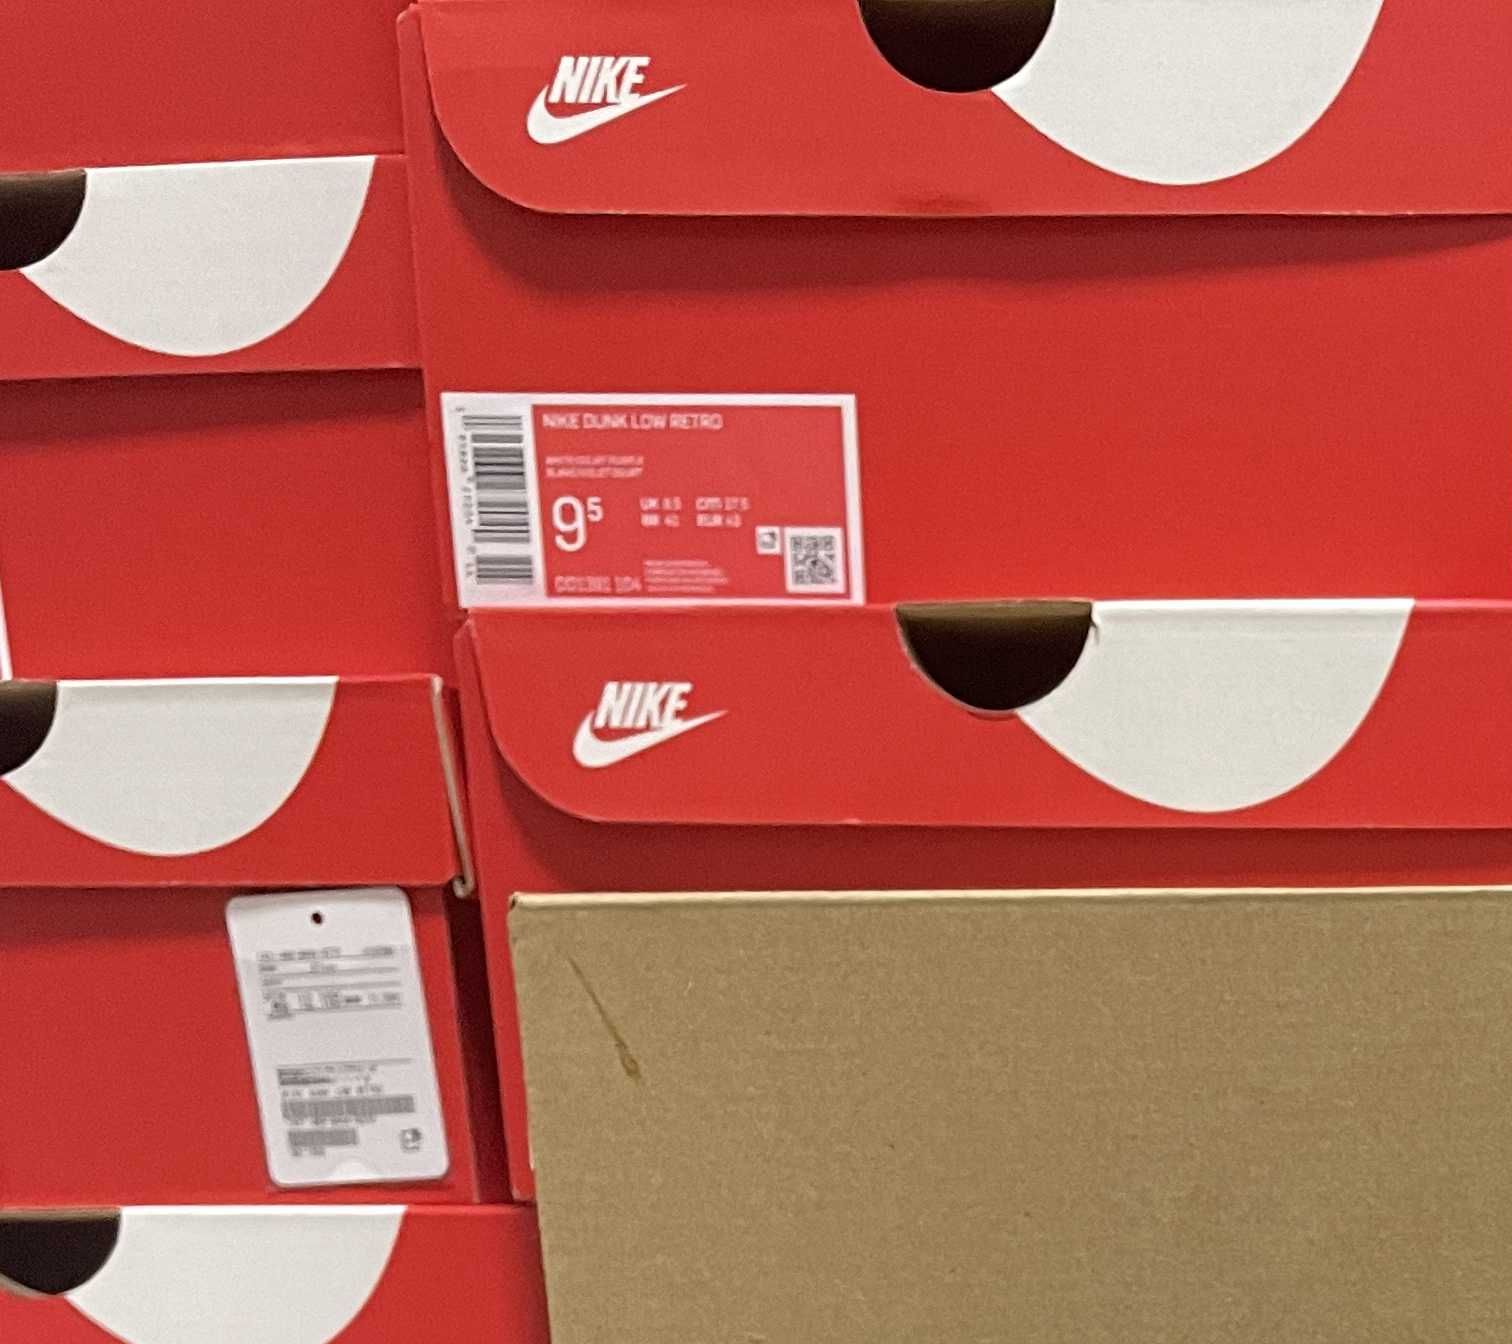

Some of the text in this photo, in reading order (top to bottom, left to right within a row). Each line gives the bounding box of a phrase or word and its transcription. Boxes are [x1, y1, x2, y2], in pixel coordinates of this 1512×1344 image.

[547, 55, 652, 104] NIKE
[542, 413, 724, 431] NIKE DUNK LOW RETRO
[593, 681, 694, 729] NIKE
